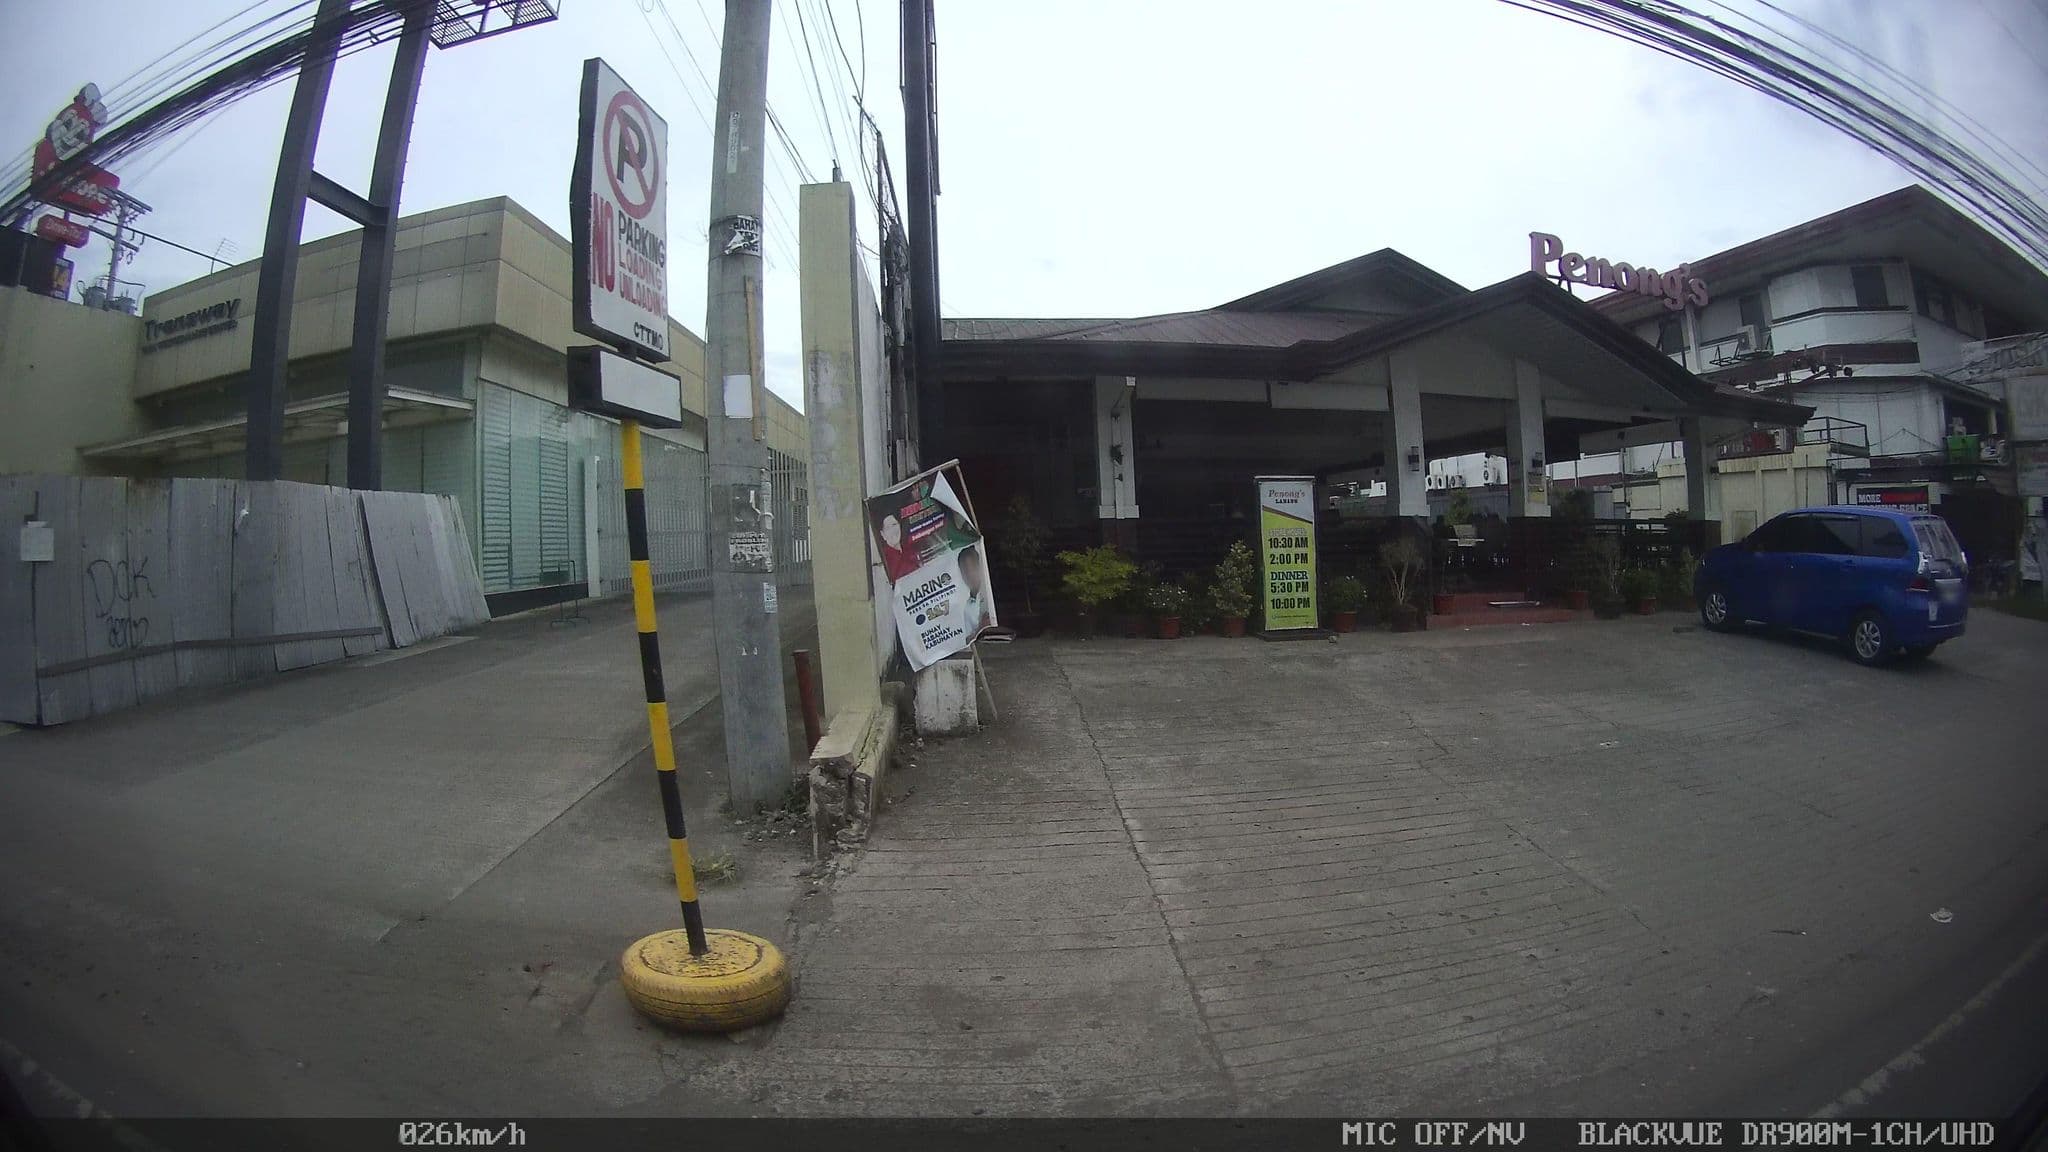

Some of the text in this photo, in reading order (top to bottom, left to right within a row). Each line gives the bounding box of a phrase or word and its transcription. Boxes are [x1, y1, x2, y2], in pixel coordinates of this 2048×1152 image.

[592, 192, 616, 293] NO
[618, 209, 665, 268] PARKING
[618, 242, 662, 291] LOADING
[1529, 231, 1710, 311] Penong's
[1268, 537, 1309, 549] 10:30 AM
[1269, 553, 1309, 565] 2:00 PM
[1270, 570, 1309, 581] DINNER
[902, 572, 952, 608] MARINO
[1270, 582, 1310, 594] 5:30 PM
[1270, 597, 1311, 610] 10:00 PM
